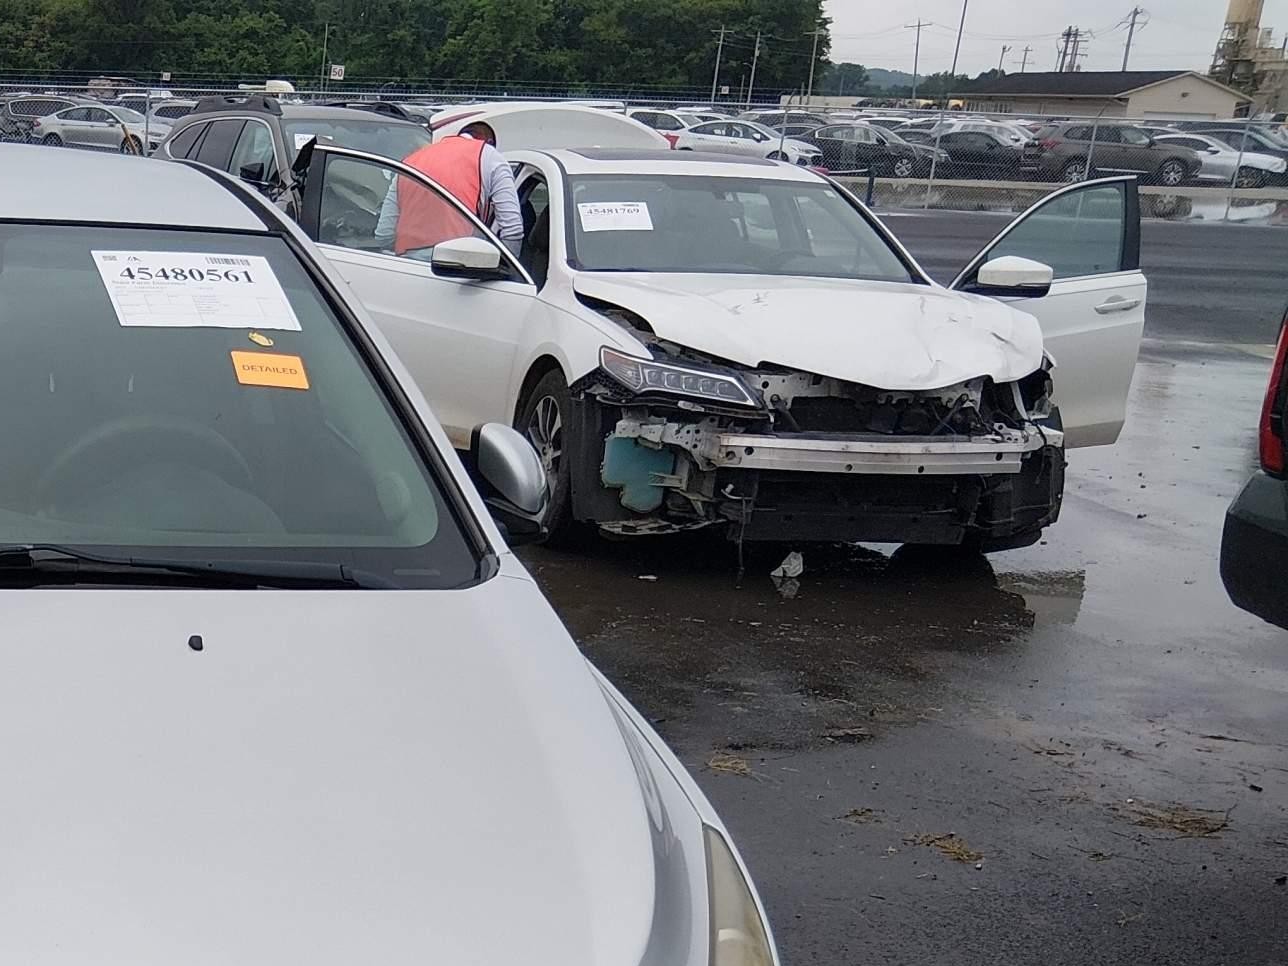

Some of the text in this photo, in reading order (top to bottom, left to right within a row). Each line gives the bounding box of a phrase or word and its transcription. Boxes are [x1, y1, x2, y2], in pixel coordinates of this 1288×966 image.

[332, 67, 343, 77] 50
[119, 266, 257, 284] 45480561
[242, 364, 298, 375] DETAILED
